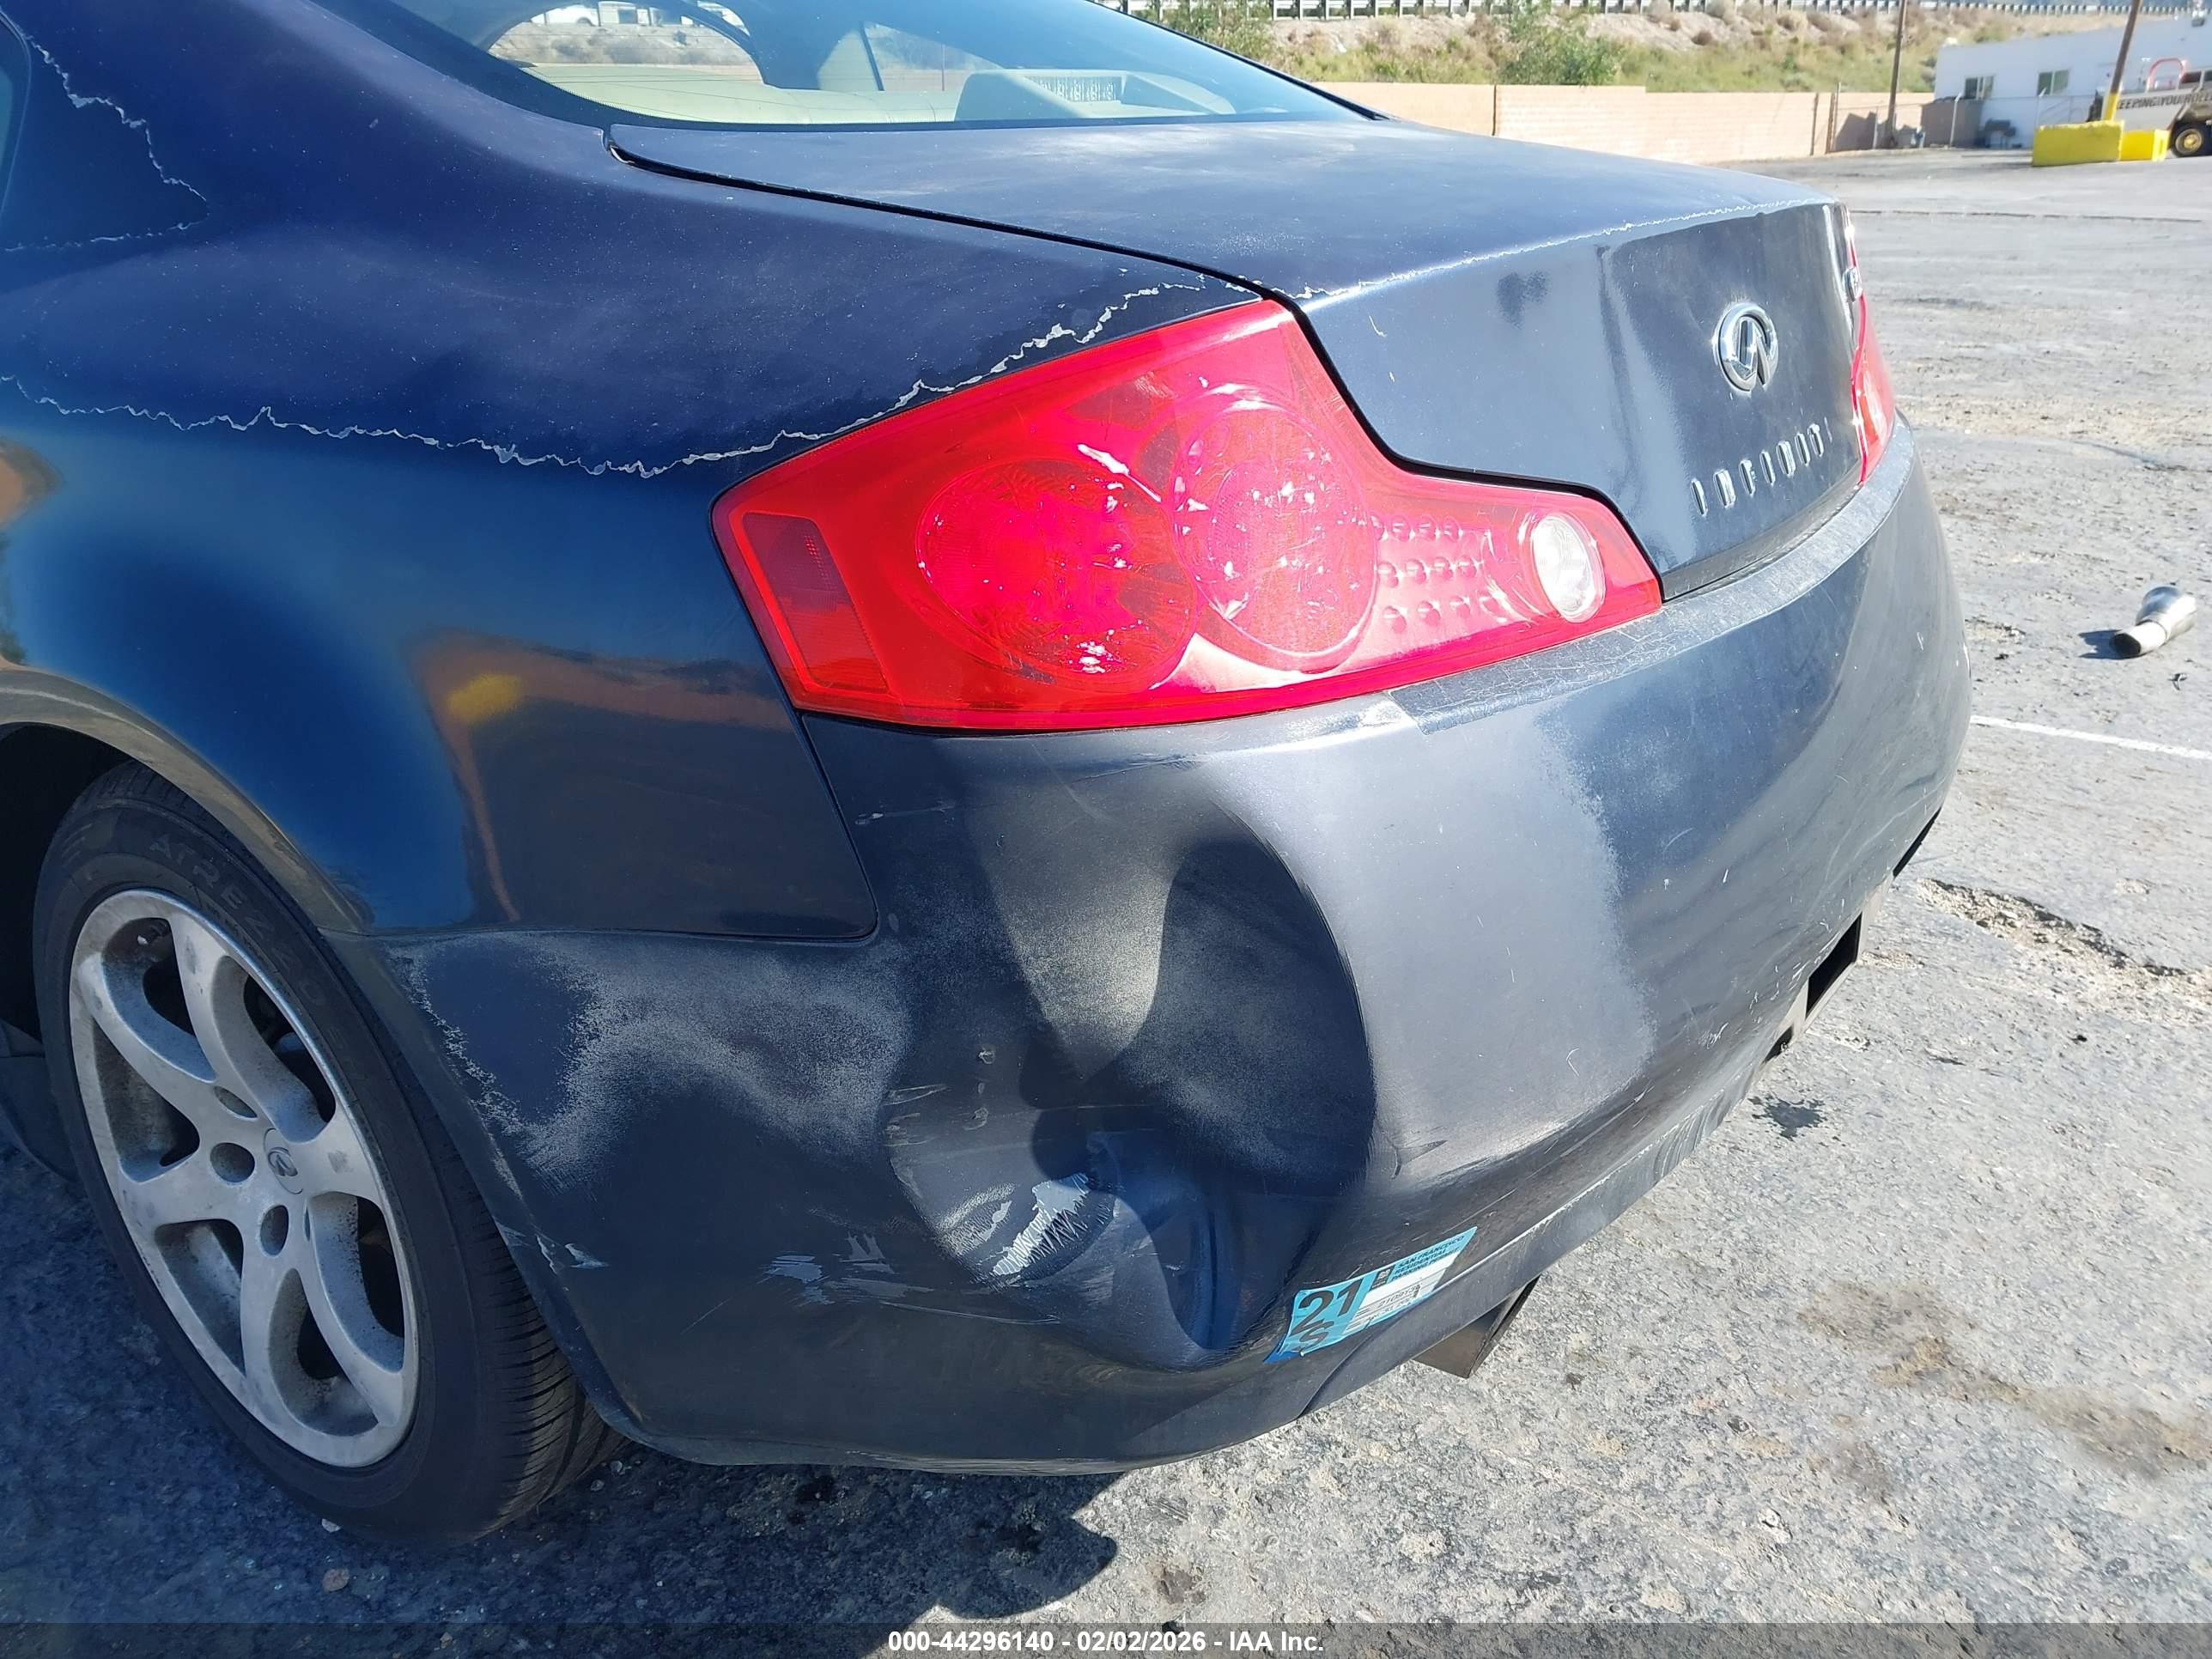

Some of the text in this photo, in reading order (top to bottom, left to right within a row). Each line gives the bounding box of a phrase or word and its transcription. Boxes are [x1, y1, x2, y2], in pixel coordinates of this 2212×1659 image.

[2160, 94, 2181, 106] YOU
[1395, 1249, 1447, 1274] RESIDENTIAL
[1398, 1236, 1465, 1267] SAN FRANCISCO
[1391, 1260, 1429, 1281] PARKING
[1289, 1278, 1364, 1336] 21
[1297, 1321, 1334, 1350] S
